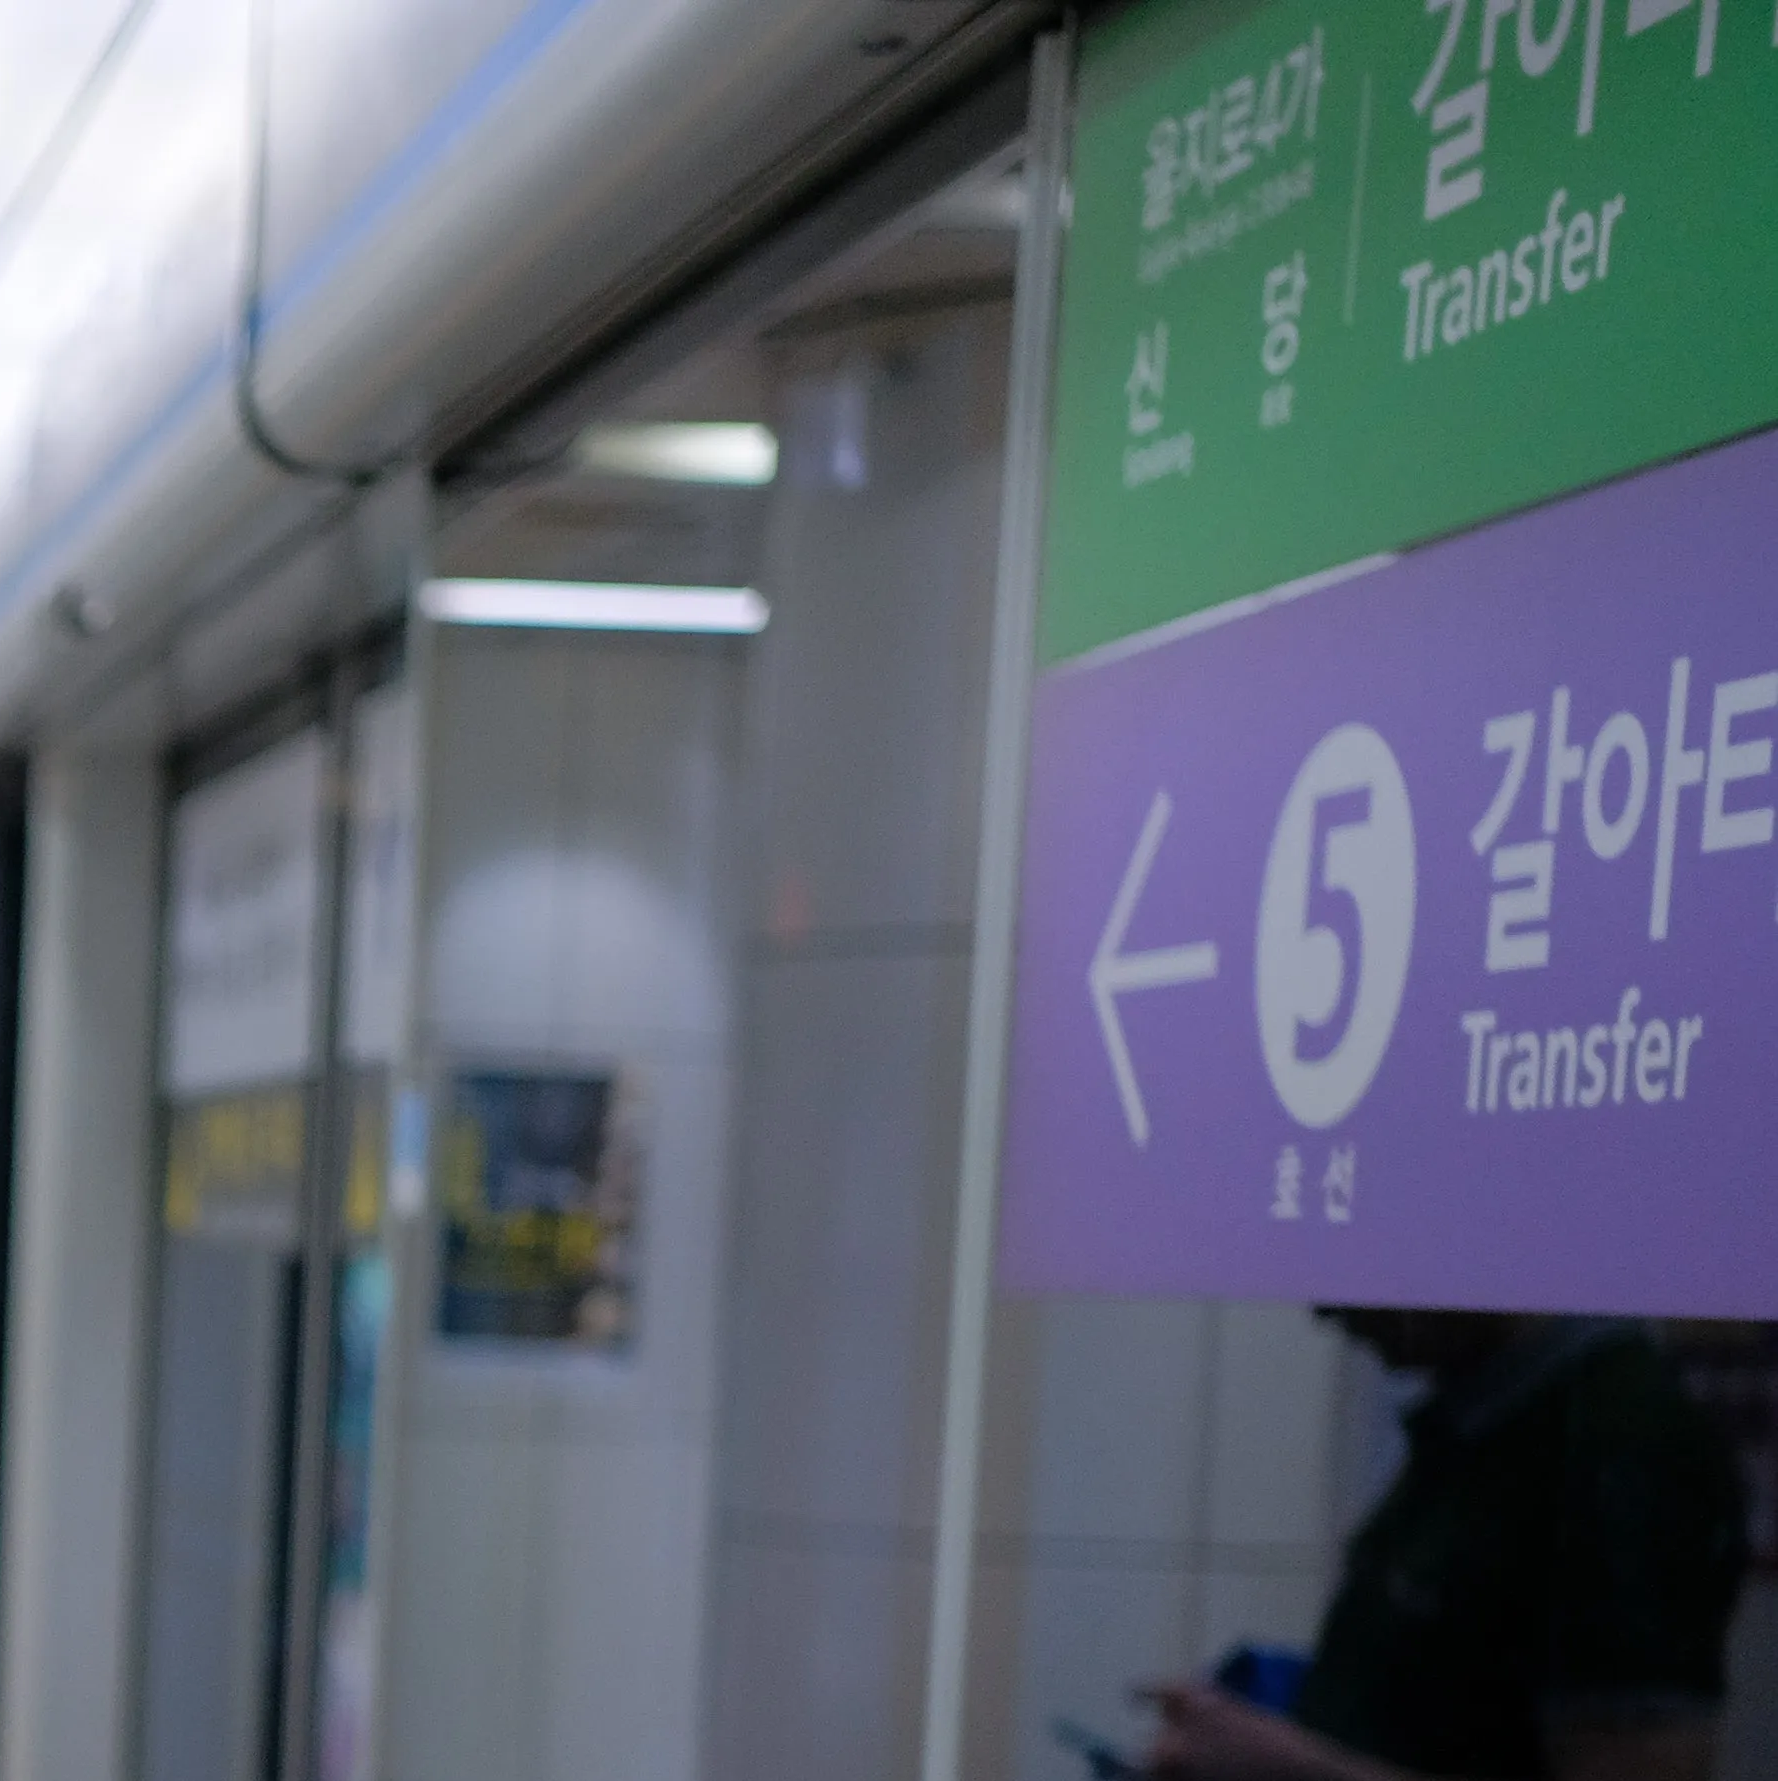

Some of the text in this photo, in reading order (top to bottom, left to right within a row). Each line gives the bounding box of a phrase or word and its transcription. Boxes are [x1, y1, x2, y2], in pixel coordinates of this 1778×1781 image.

[1400, 189, 1625, 361] Transfer
[1293, 783, 1373, 1066] 5
[1461, 986, 1703, 1114] Transfer
